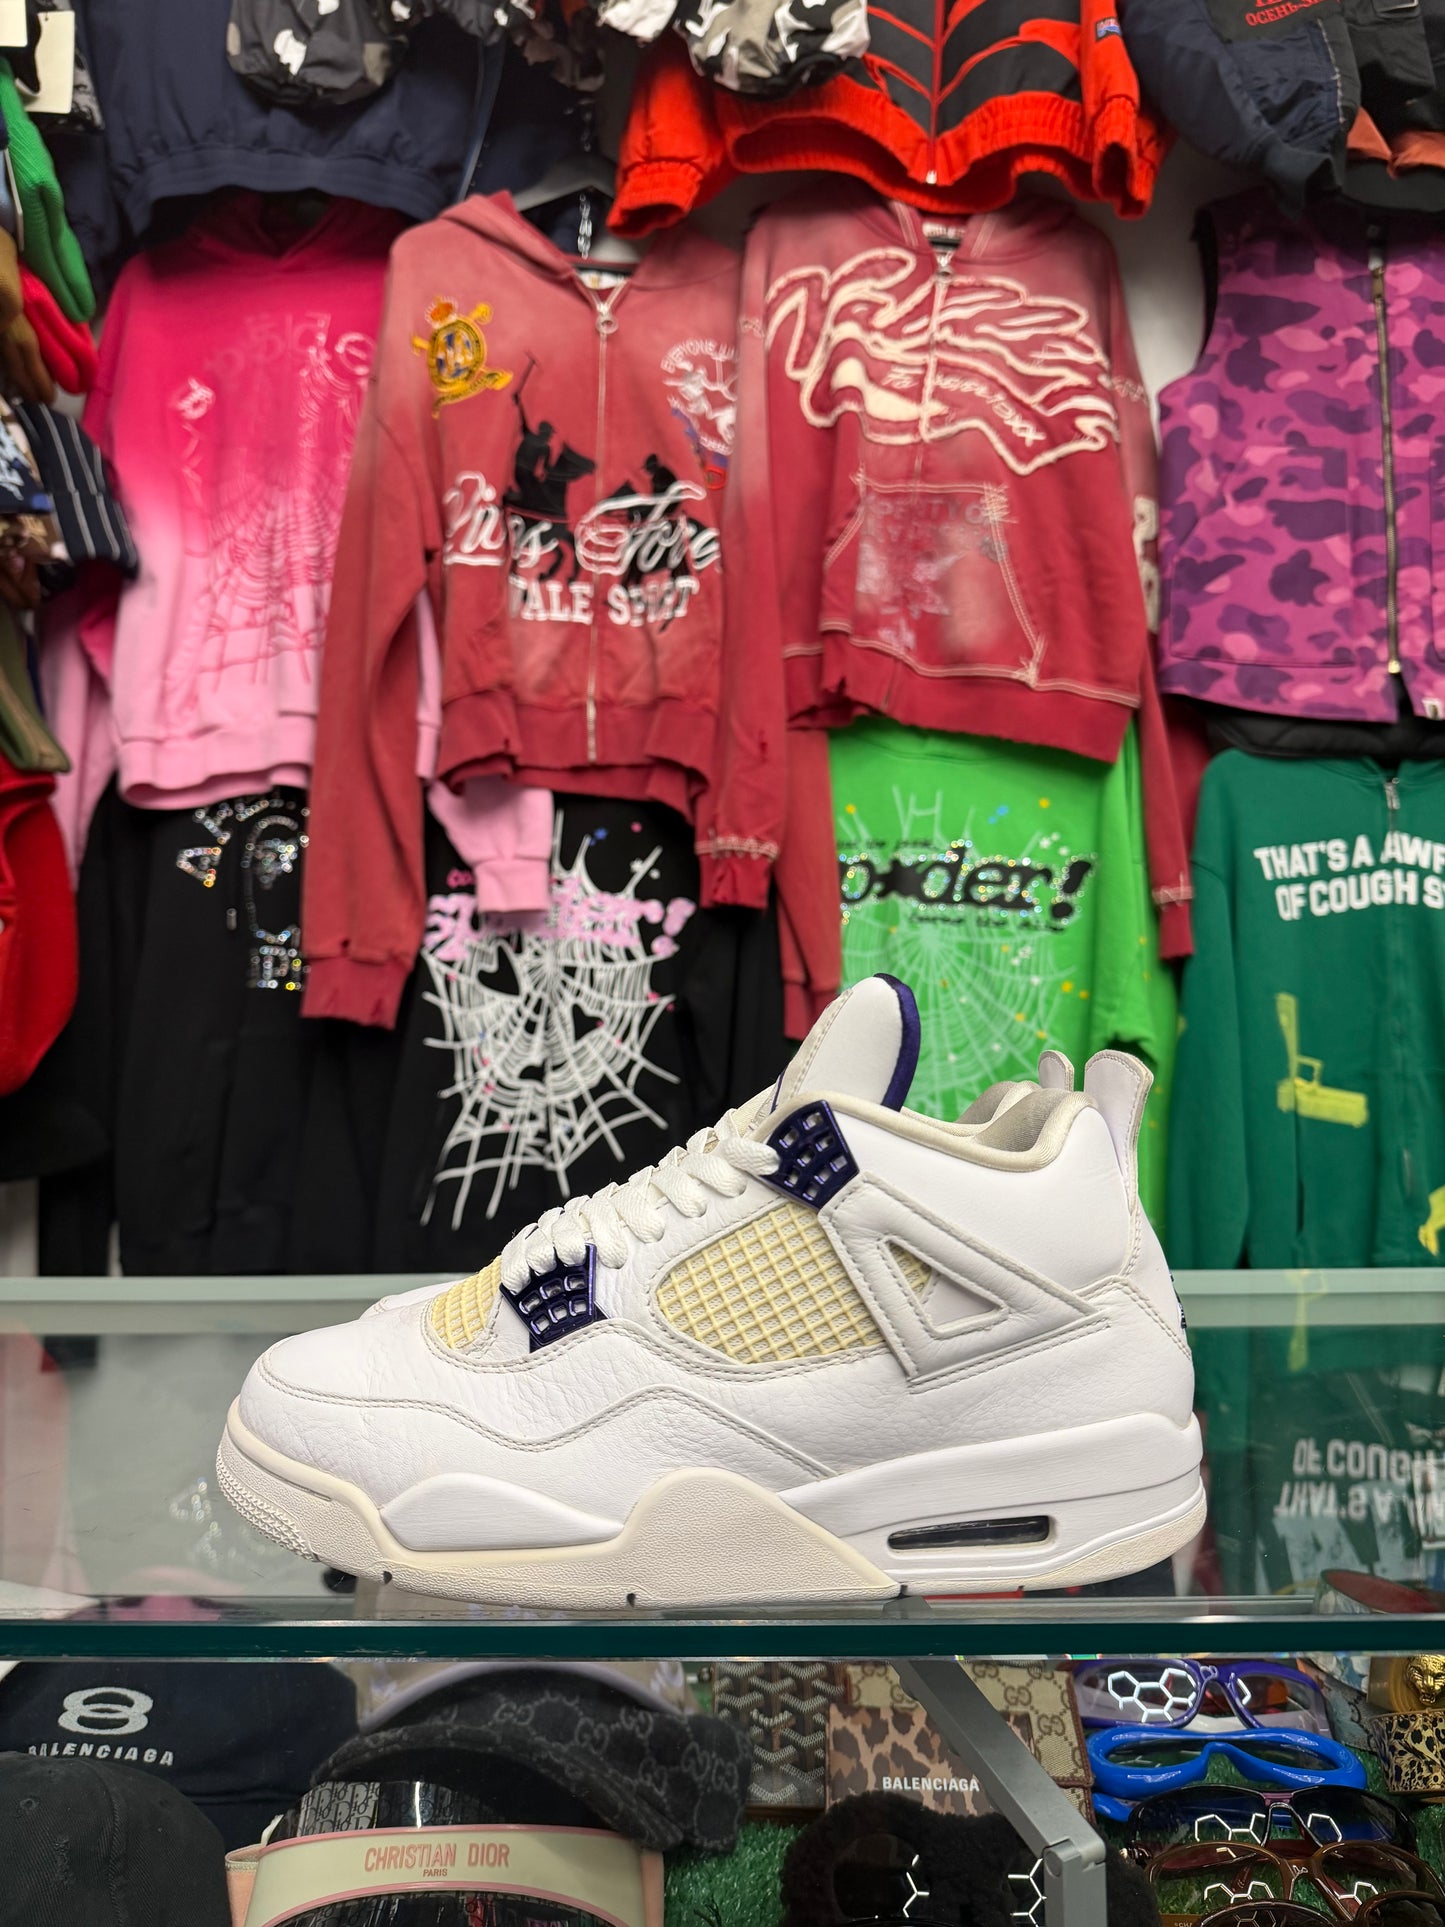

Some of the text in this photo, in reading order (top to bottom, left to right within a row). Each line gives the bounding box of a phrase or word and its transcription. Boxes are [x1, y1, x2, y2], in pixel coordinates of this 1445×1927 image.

[1253, 838, 1349, 881] THAT'S
[1351, 833, 1374, 869] A
[1274, 868, 1445, 921] OF COUGH S
[882, 1776, 980, 1792] BALENCIAGA
[364, 1842, 511, 1873] CHRISTIAN DIOR
[422, 1868, 448, 1878] PARIS
